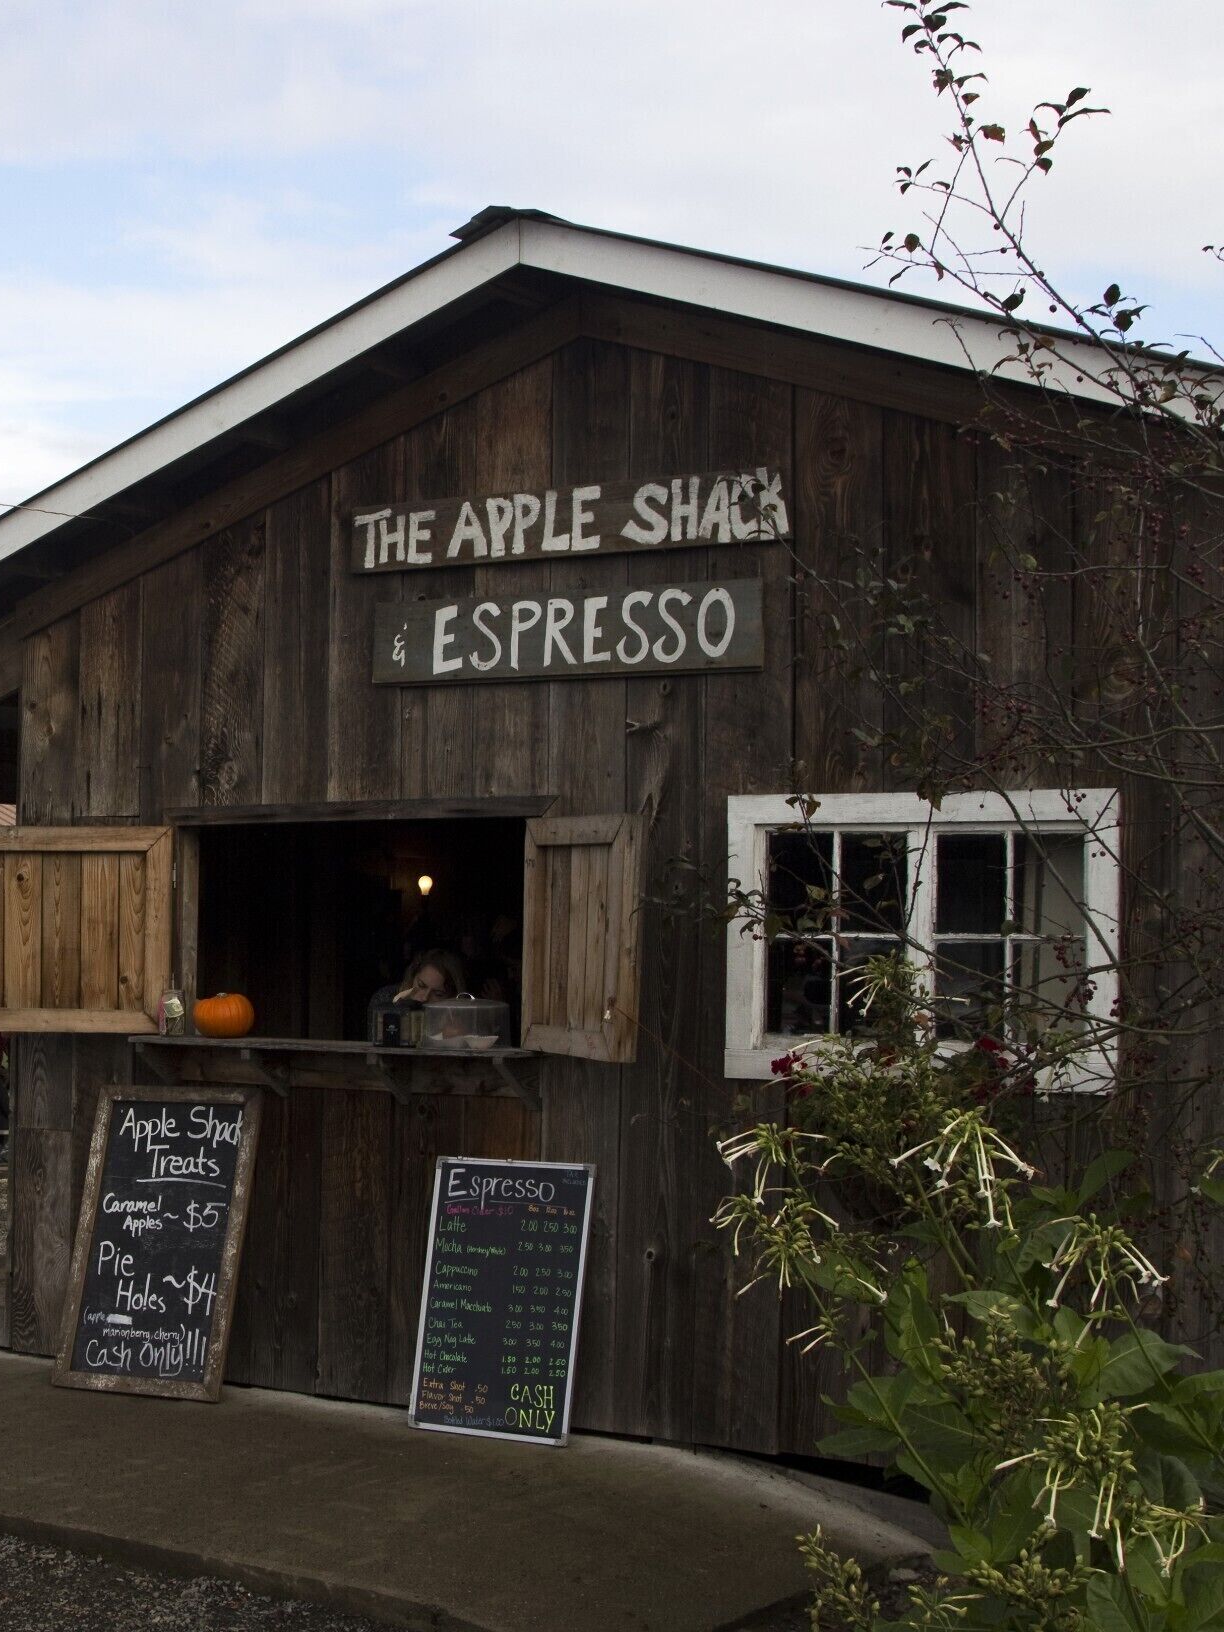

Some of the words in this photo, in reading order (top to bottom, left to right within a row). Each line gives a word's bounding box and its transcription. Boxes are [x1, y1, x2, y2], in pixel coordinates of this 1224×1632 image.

[354, 508, 437, 569] THE
[447, 485, 601, 558] APPLE
[620, 467, 791, 545] SHACK
[432, 587, 735, 675] ESPRESSO
[119, 1107, 180, 1153] Apple
[149, 1145, 220, 1178] Treats
[448, 1168, 555, 1210] Espresso
[103, 1192, 162, 1214] Caramel
[123, 1215, 163, 1237] Apples
[183, 1200, 226, 1232] $5
[439, 1215, 467, 1233] Latte
[435, 1237, 462, 1253] Mocha
[97, 1241, 135, 1276] Pie
[116, 1272, 166, 1313] Holes
[183, 1265, 217, 1316] $4
[433, 1280, 472, 1292] Americano
[430, 1297, 458, 1309] Caramel
[448, 1318, 463, 1329] Tea
[86, 1339, 132, 1371] Cash
[139, 1328, 207, 1377] Only!!!
[426, 1333, 442, 1348] Egg
[422, 1362, 435, 1373] Hot
[424, 1349, 437, 1360] Hot
[439, 1351, 468, 1363] Chocolate
[423, 1377, 444, 1390] Extra
[510, 1383, 554, 1409] CASH
[505, 1407, 555, 1433] ONLY
